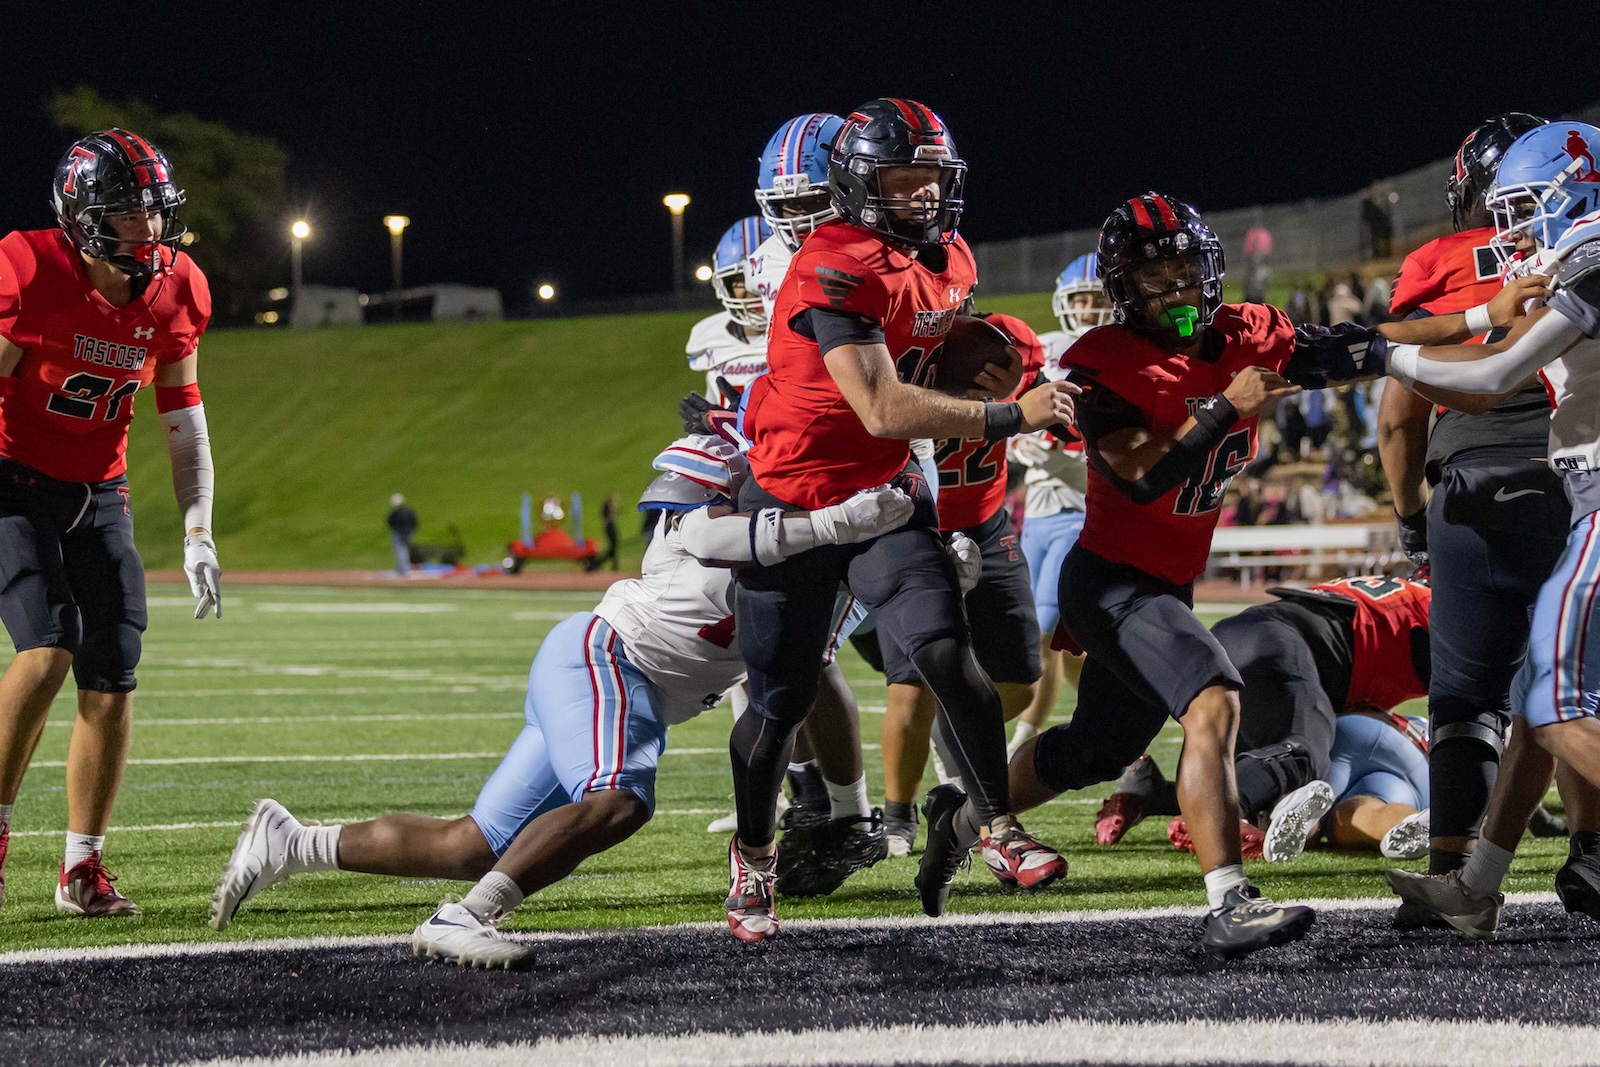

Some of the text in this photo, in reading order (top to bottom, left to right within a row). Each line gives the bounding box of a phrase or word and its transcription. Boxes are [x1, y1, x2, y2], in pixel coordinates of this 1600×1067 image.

[63, 146, 95, 199] T
[74, 333, 148, 370] TASCOSA
[46, 371, 142, 421] 21
[1000, 534, 1019, 562] T
